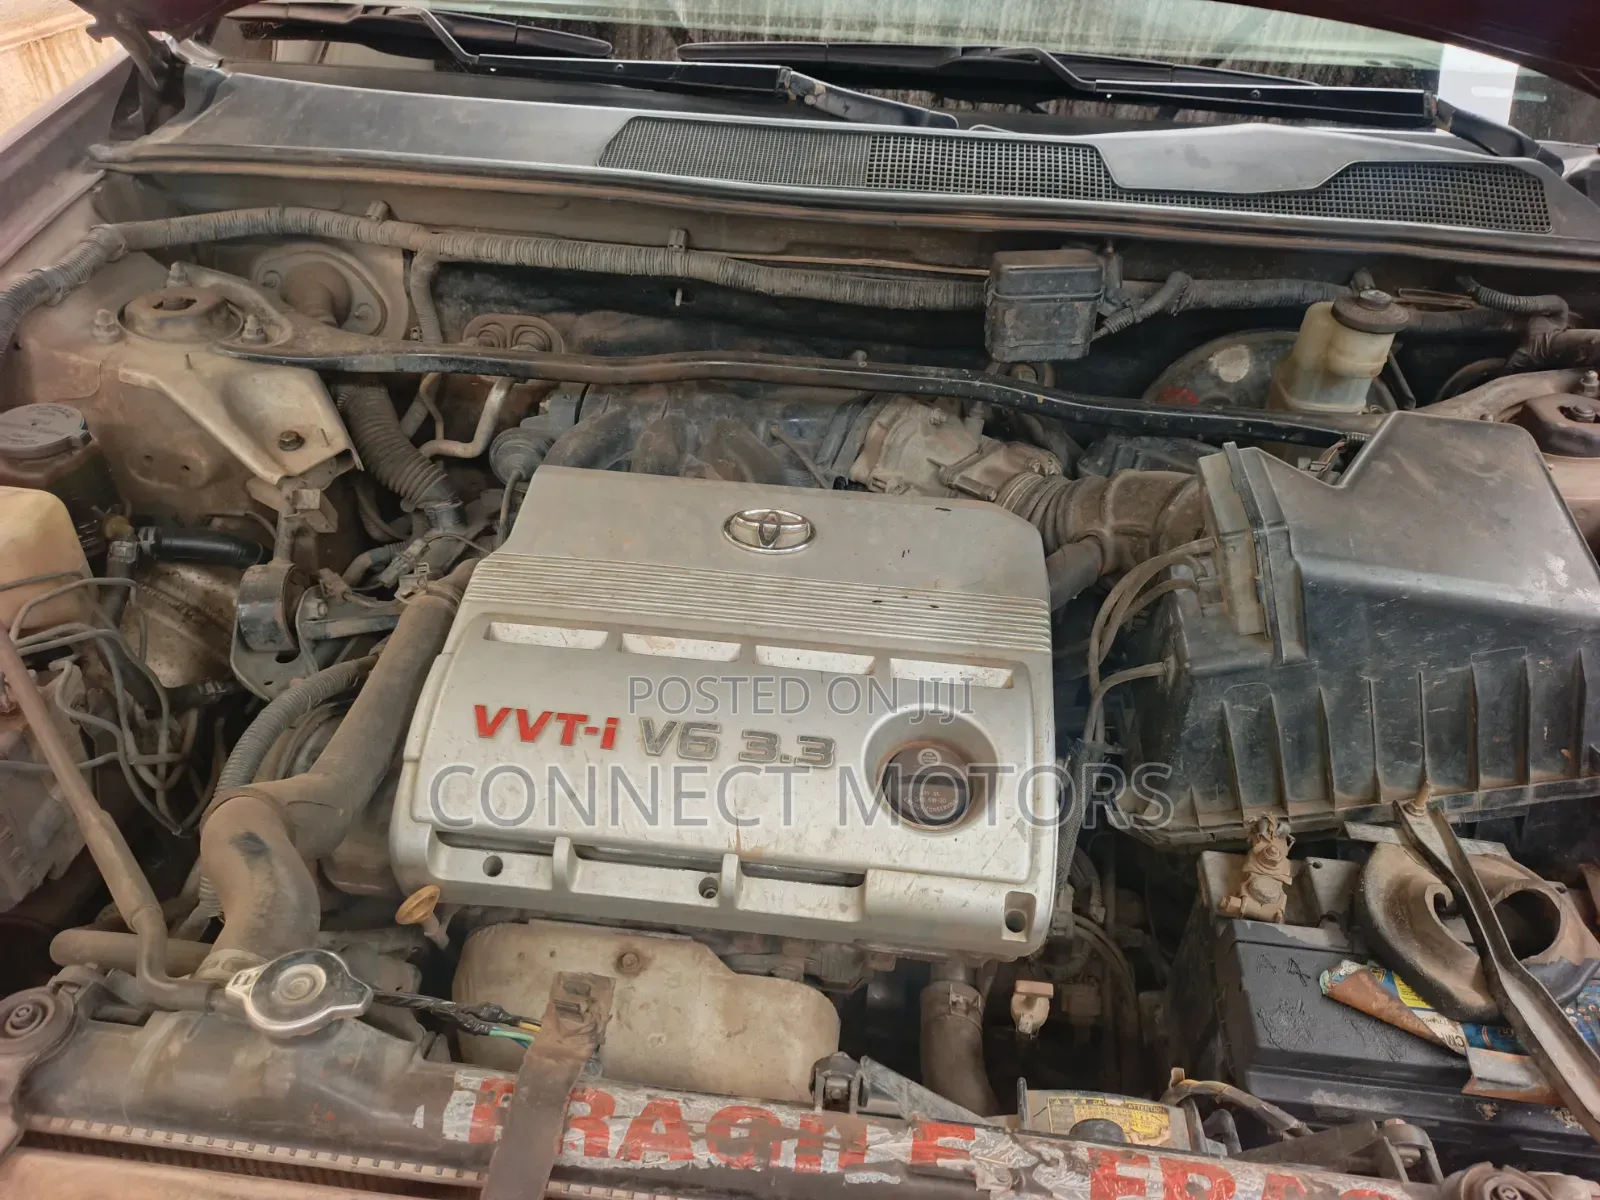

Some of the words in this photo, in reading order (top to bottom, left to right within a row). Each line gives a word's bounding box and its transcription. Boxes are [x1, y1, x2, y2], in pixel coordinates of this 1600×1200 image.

[474, 704, 620, 750] VVT-i
[639, 716, 722, 761] V6
[737, 729, 836, 769] 3.3
